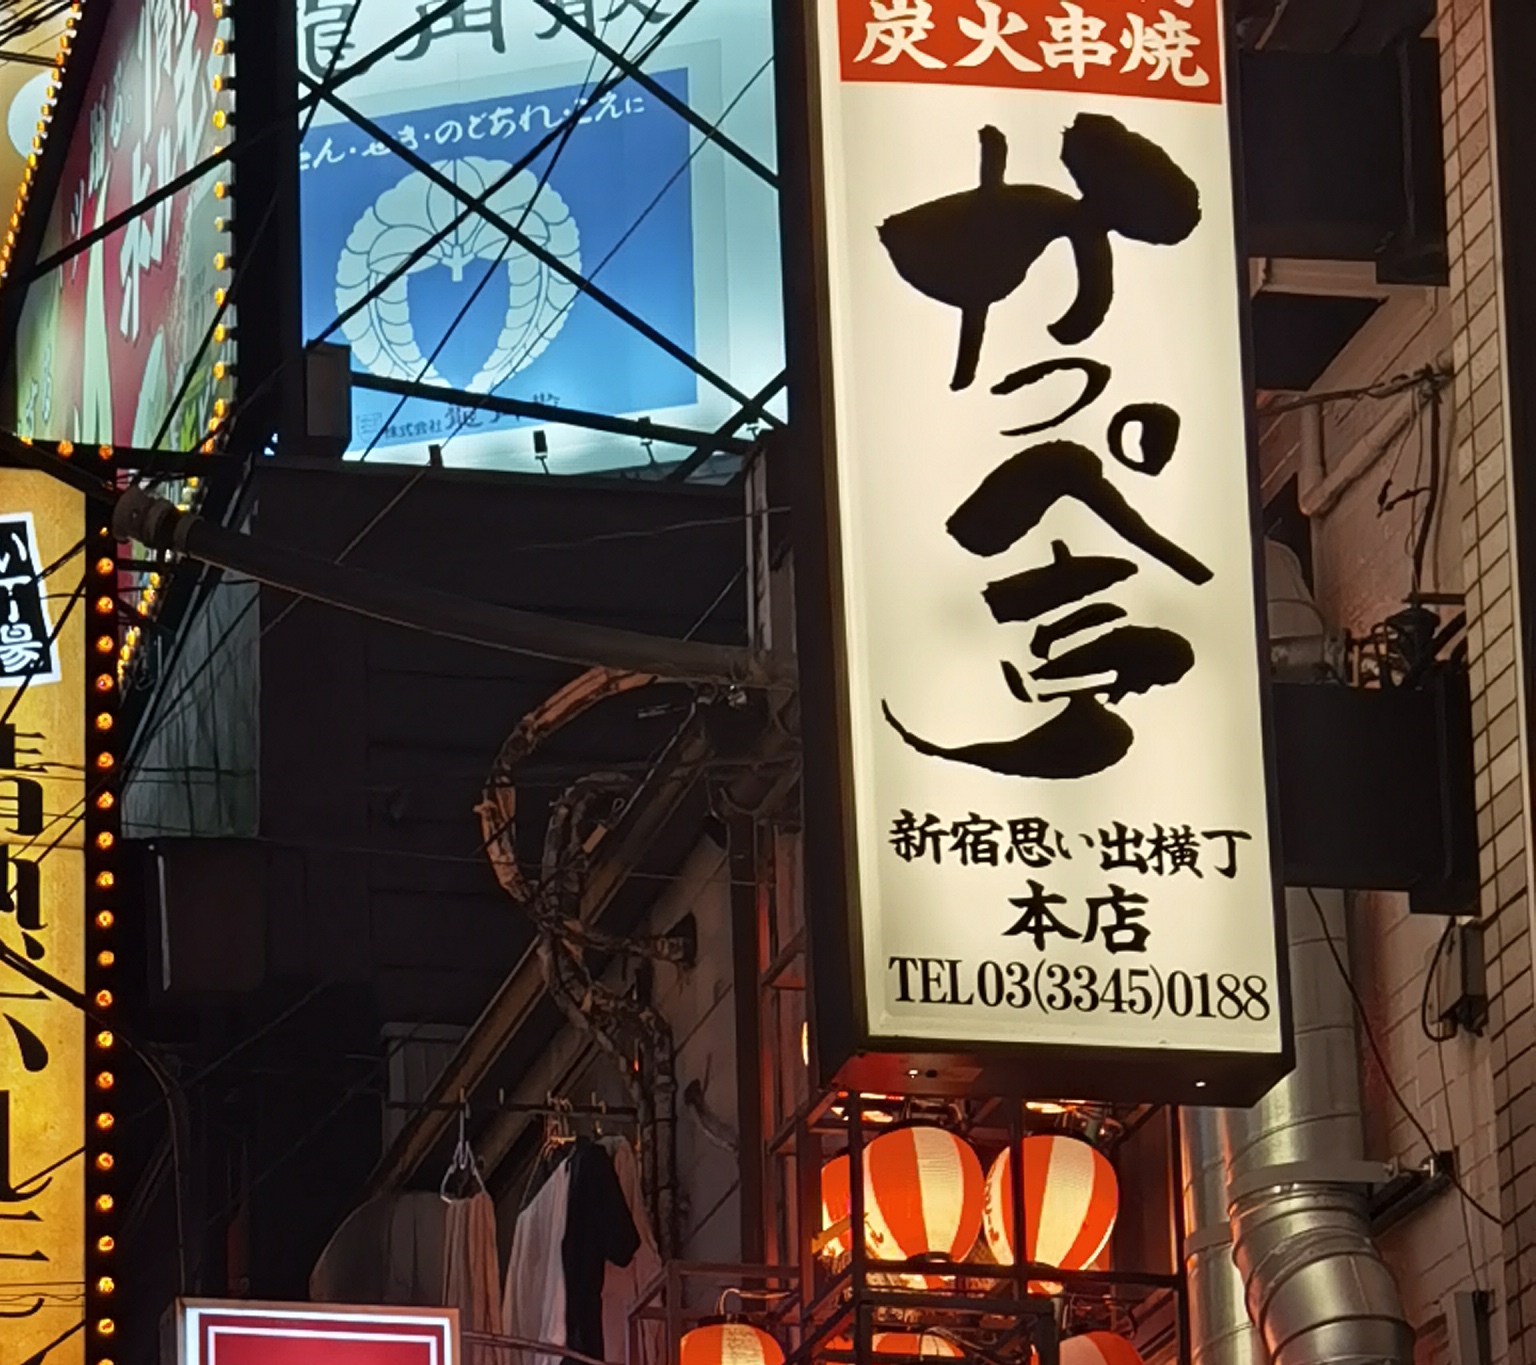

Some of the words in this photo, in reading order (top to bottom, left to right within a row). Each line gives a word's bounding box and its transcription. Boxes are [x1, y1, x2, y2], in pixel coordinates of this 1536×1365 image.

[853, 0, 1210, 88] 炭火串焼
[887, 808, 1254, 880] 新宿思い出横丁
[1002, 878, 1154, 956] 本店
